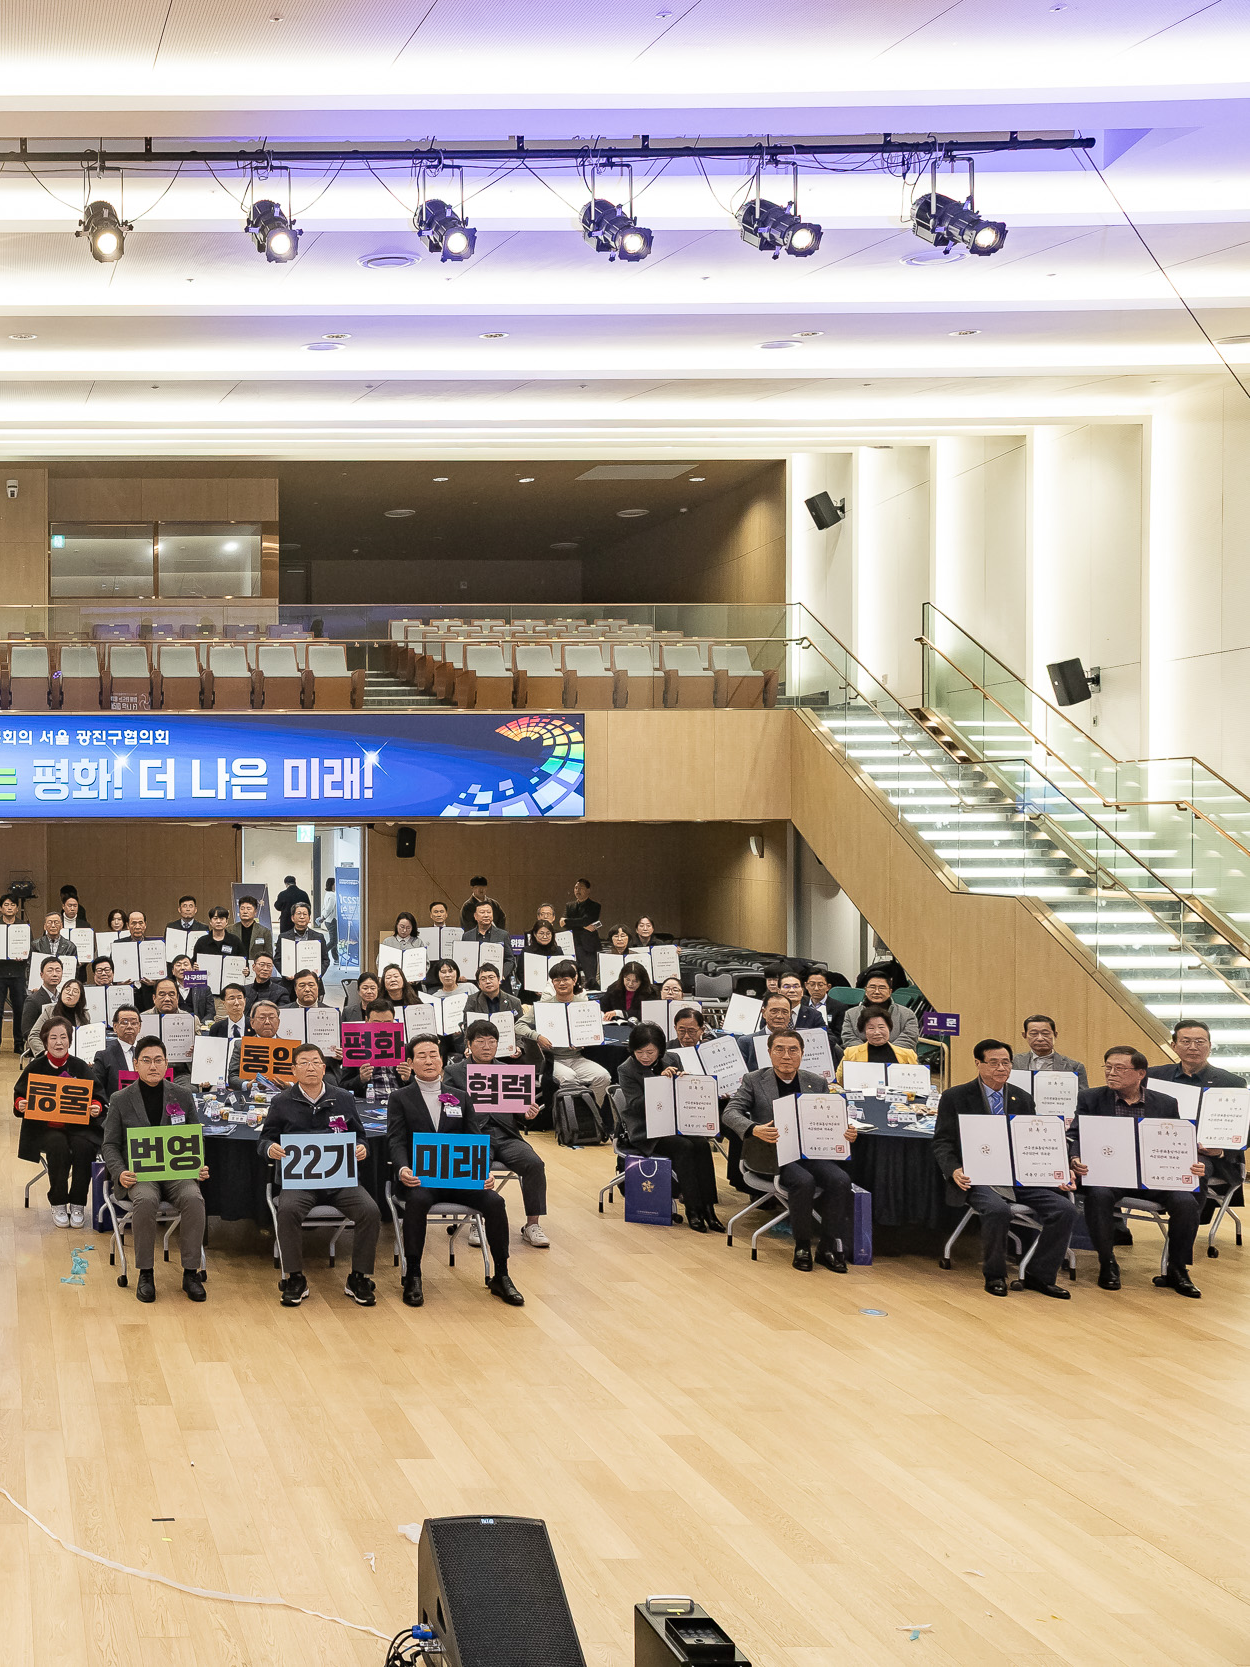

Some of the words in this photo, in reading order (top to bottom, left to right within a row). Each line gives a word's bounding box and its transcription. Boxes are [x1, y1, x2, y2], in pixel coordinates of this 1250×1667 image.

[39, 729, 70, 746] 서울
[75, 729, 170, 746] 광진구협의회
[32, 757, 123, 802] 평화!
[139, 757, 176, 801] 더
[191, 757, 269, 801] 나은
[283, 757, 374, 801] 미래!
[510, 938, 525, 948] 위원
[242, 1044, 293, 1075] 통일
[343, 1030, 405, 1061] 평화
[468, 1073, 532, 1106] 협력
[129, 1134, 200, 1173] 번영
[283, 1142, 356, 1180] 22기
[415, 1143, 488, 1181] 미래
